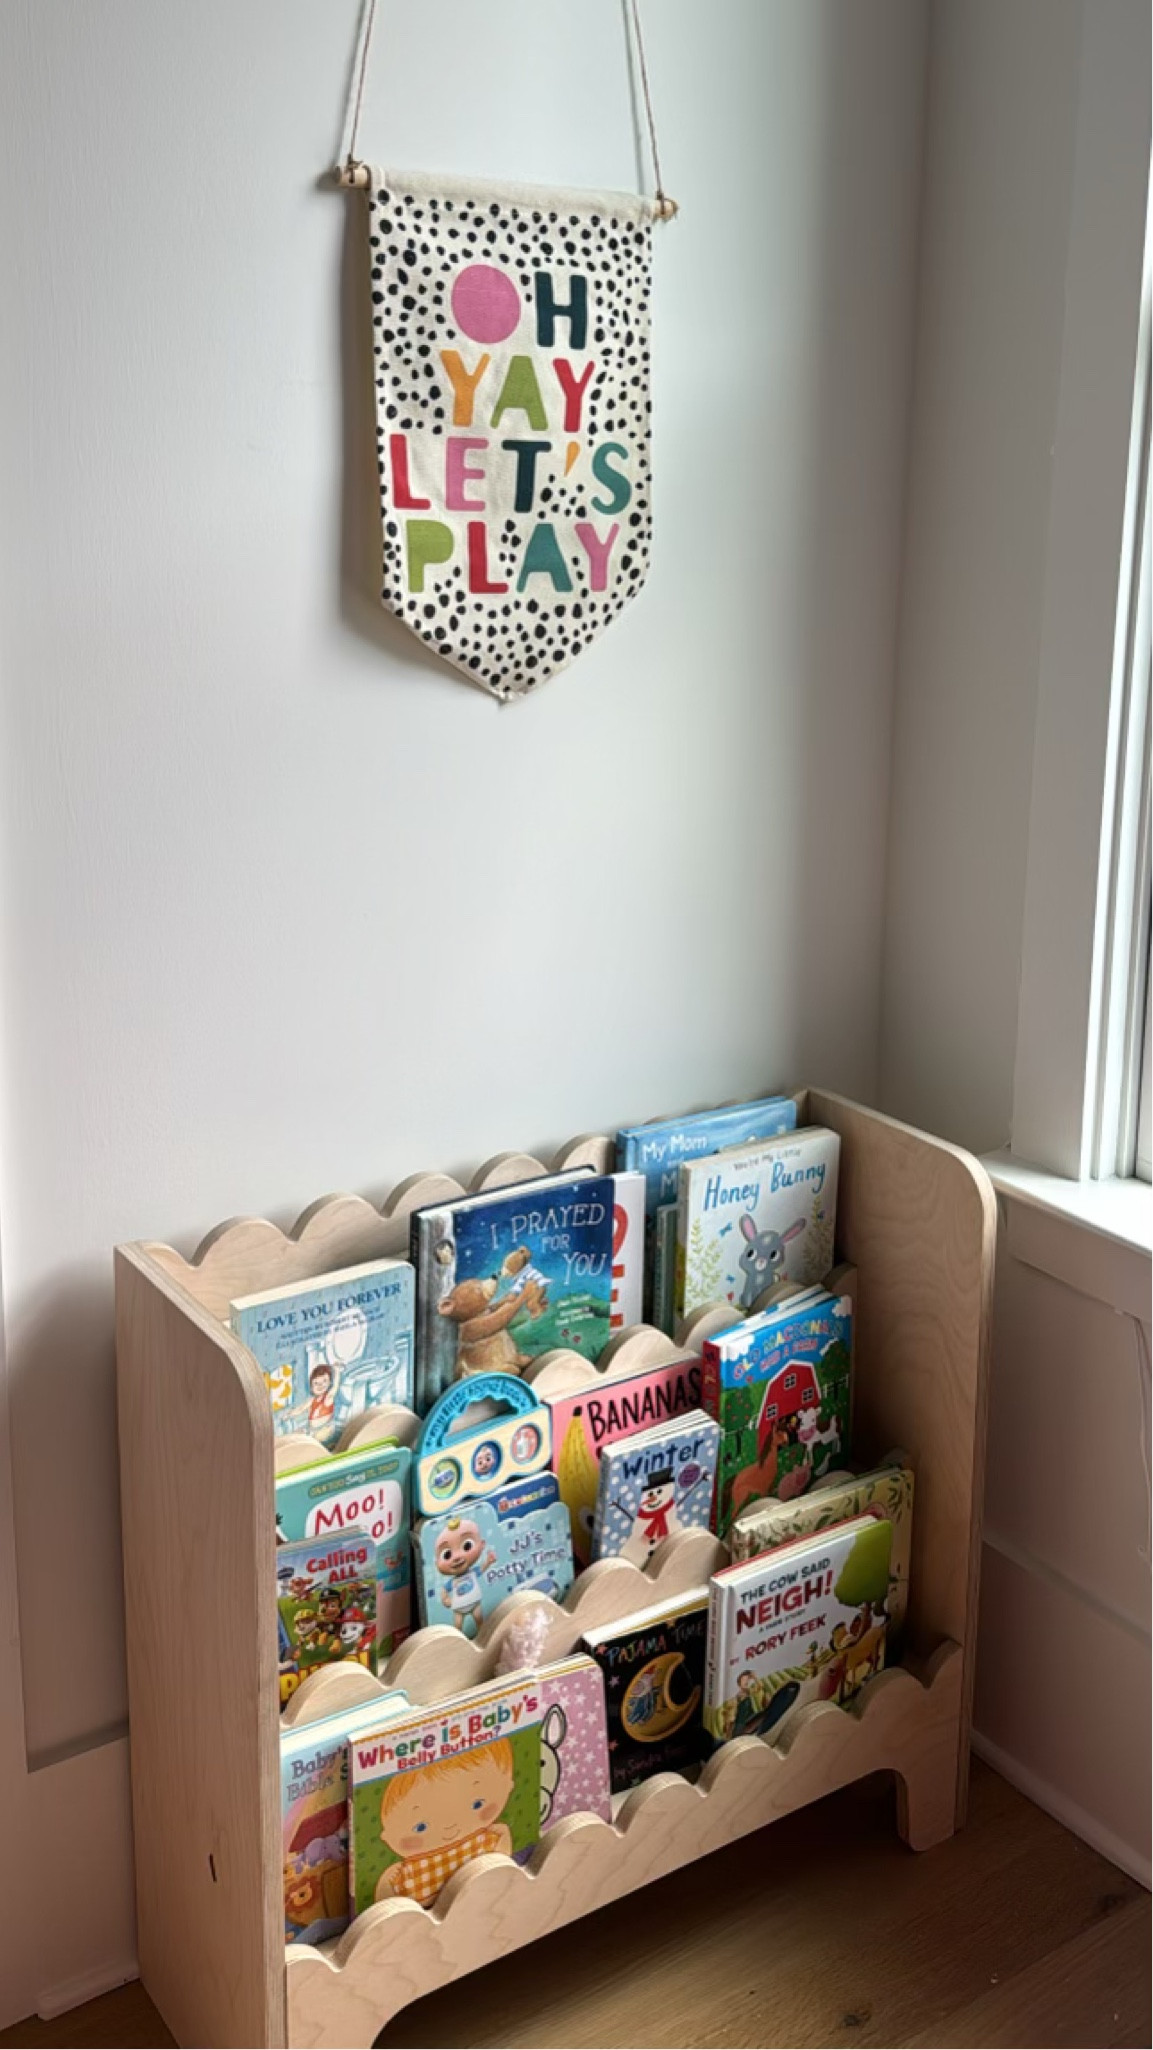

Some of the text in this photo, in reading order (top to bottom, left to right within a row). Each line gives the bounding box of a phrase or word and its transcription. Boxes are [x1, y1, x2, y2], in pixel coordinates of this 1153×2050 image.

[451, 264, 588, 350] OH
[440, 350, 596, 433] YAY
[390, 434, 631, 516] LET'S
[406, 519, 620, 594] PLAY
[642, 1134, 708, 1163] My Mom
[704, 1161, 826, 1212] Honey Bunny
[490, 1203, 605, 1250] I PRAYED
[541, 1235, 570, 1252] FOR
[563, 1253, 608, 1284] YOU
[257, 1311, 298, 1333] LOVE
[301, 1301, 334, 1321] YOU
[338, 1282, 401, 1312] FOREVER
[734, 1348, 760, 1379] OLD
[587, 1367, 702, 1442] BANANAS
[345, 1472, 367, 1485] Say
[623, 1438, 705, 1480] Winter
[315, 1488, 384, 1537] Moo!
[306, 1547, 368, 1573] Calling
[510, 1531, 544, 1554] JJ's
[328, 1565, 358, 1585] ALL
[486, 1547, 565, 1584] Potty Time
[741, 1557, 831, 1603] THE COW SAID
[736, 1570, 833, 1634] NEIGH!
[605, 1634, 667, 1668] PAJAMA
[745, 1631, 788, 1661] RORY
[790, 1613, 827, 1640] FEEK
[358, 1734, 436, 1769] Where
[440, 1719, 462, 1743] is
[468, 1694, 538, 1734] Baby's
[397, 1749, 436, 1770] Belly
[440, 1725, 502, 1756] Button?
[287, 1776, 335, 1802] Bible
